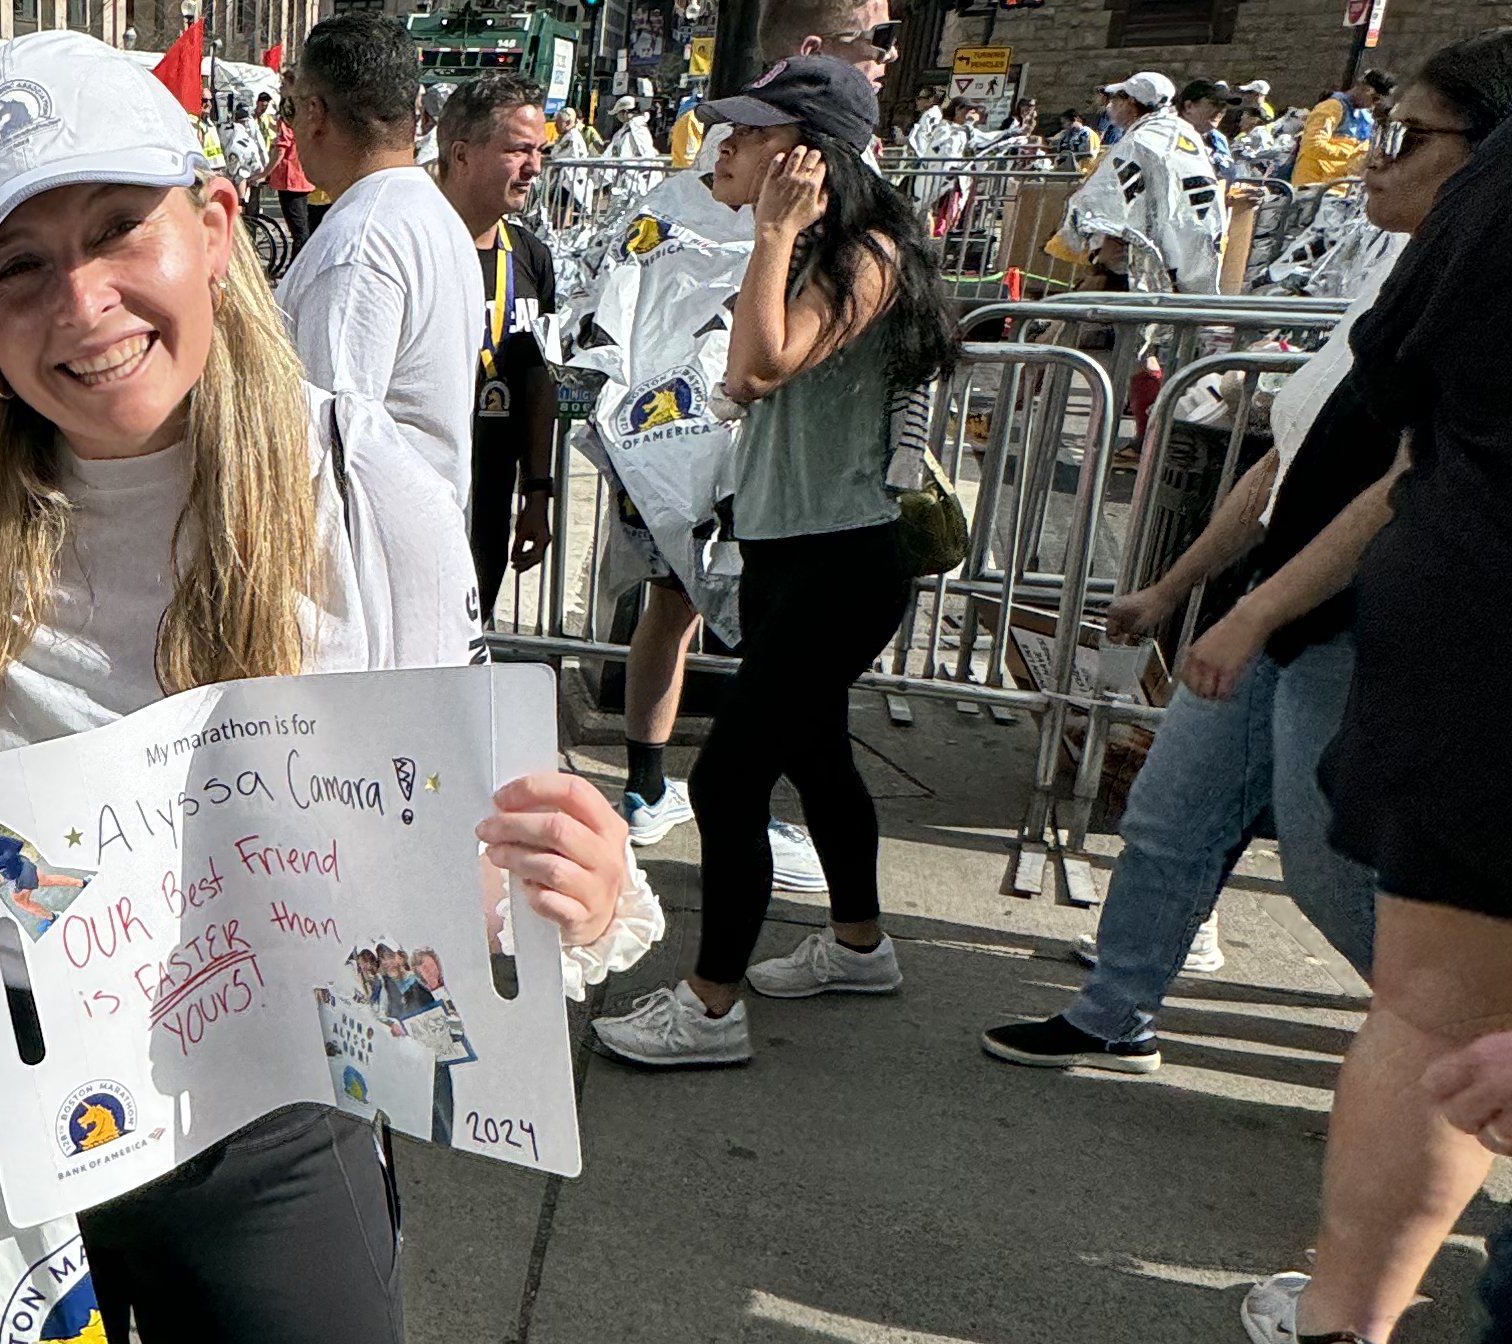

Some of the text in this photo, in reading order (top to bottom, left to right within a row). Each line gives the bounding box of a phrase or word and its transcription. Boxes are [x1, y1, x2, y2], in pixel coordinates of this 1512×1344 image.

[622, 425, 712, 451] OF AMERICA
[145, 713, 317, 767] My marathon is for
[97, 770, 274, 866] Alyssa
[63, 834, 342, 969] OUR Best Friend
[77, 901, 342, 1018] is FASTER than
[332, 1022, 374, 1053] ALYSSA
[60, 1084, 94, 1121] BOSTON
[99, 1082, 135, 1126] MARATHON
[57, 1139, 148, 1181] BANK OF AMERICA
[465, 1111, 539, 1162] 2024
